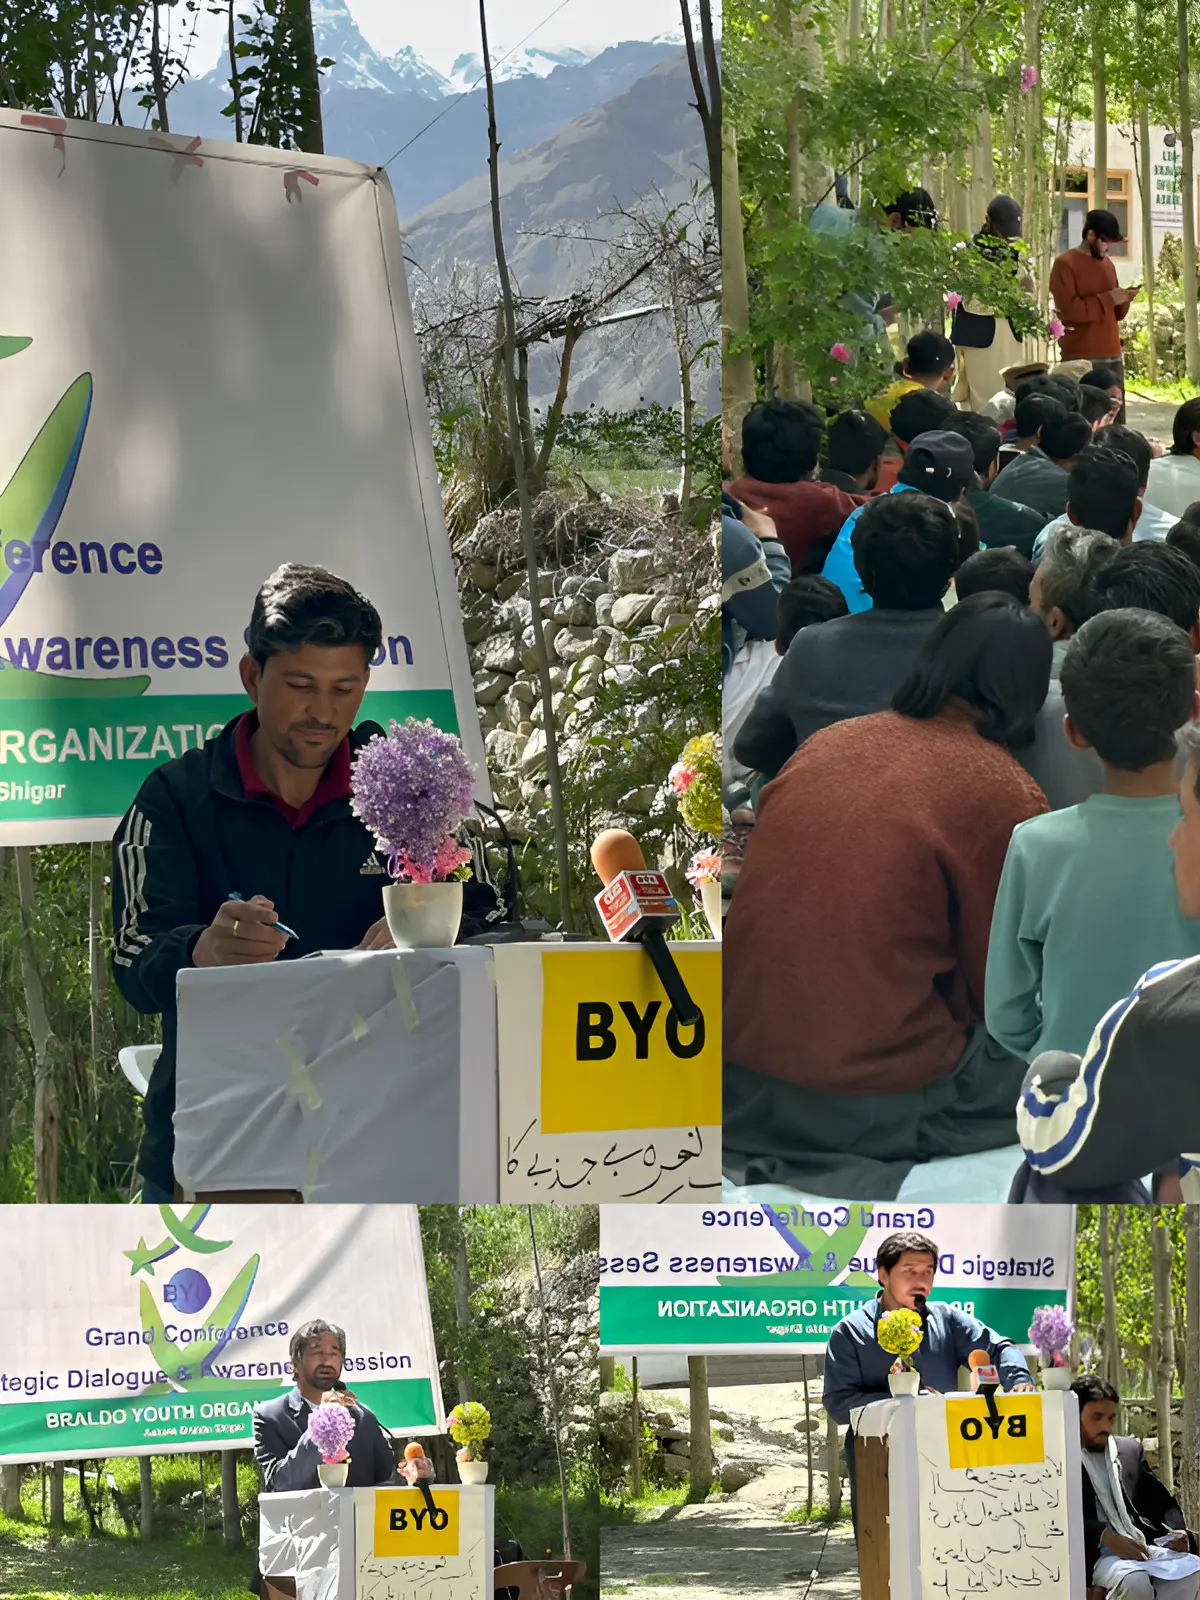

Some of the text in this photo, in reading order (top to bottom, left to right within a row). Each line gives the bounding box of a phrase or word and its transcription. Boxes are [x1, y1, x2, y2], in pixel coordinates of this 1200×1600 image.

[0, 635, 229, 670] wareness
[0, 724, 224, 765] RGANIZATI
[0, 780, 66, 805] Shigar
[576, 1001, 706, 1061] BYO
[85, 1327, 155, 1346] Grand
[68, 1368, 169, 1391] Dialogue
[343, 1351, 412, 1371] ession
[46, 1408, 127, 1429] BRALDO
[132, 1404, 195, 1423] YOUTH
[389, 1508, 449, 1531] BYO
